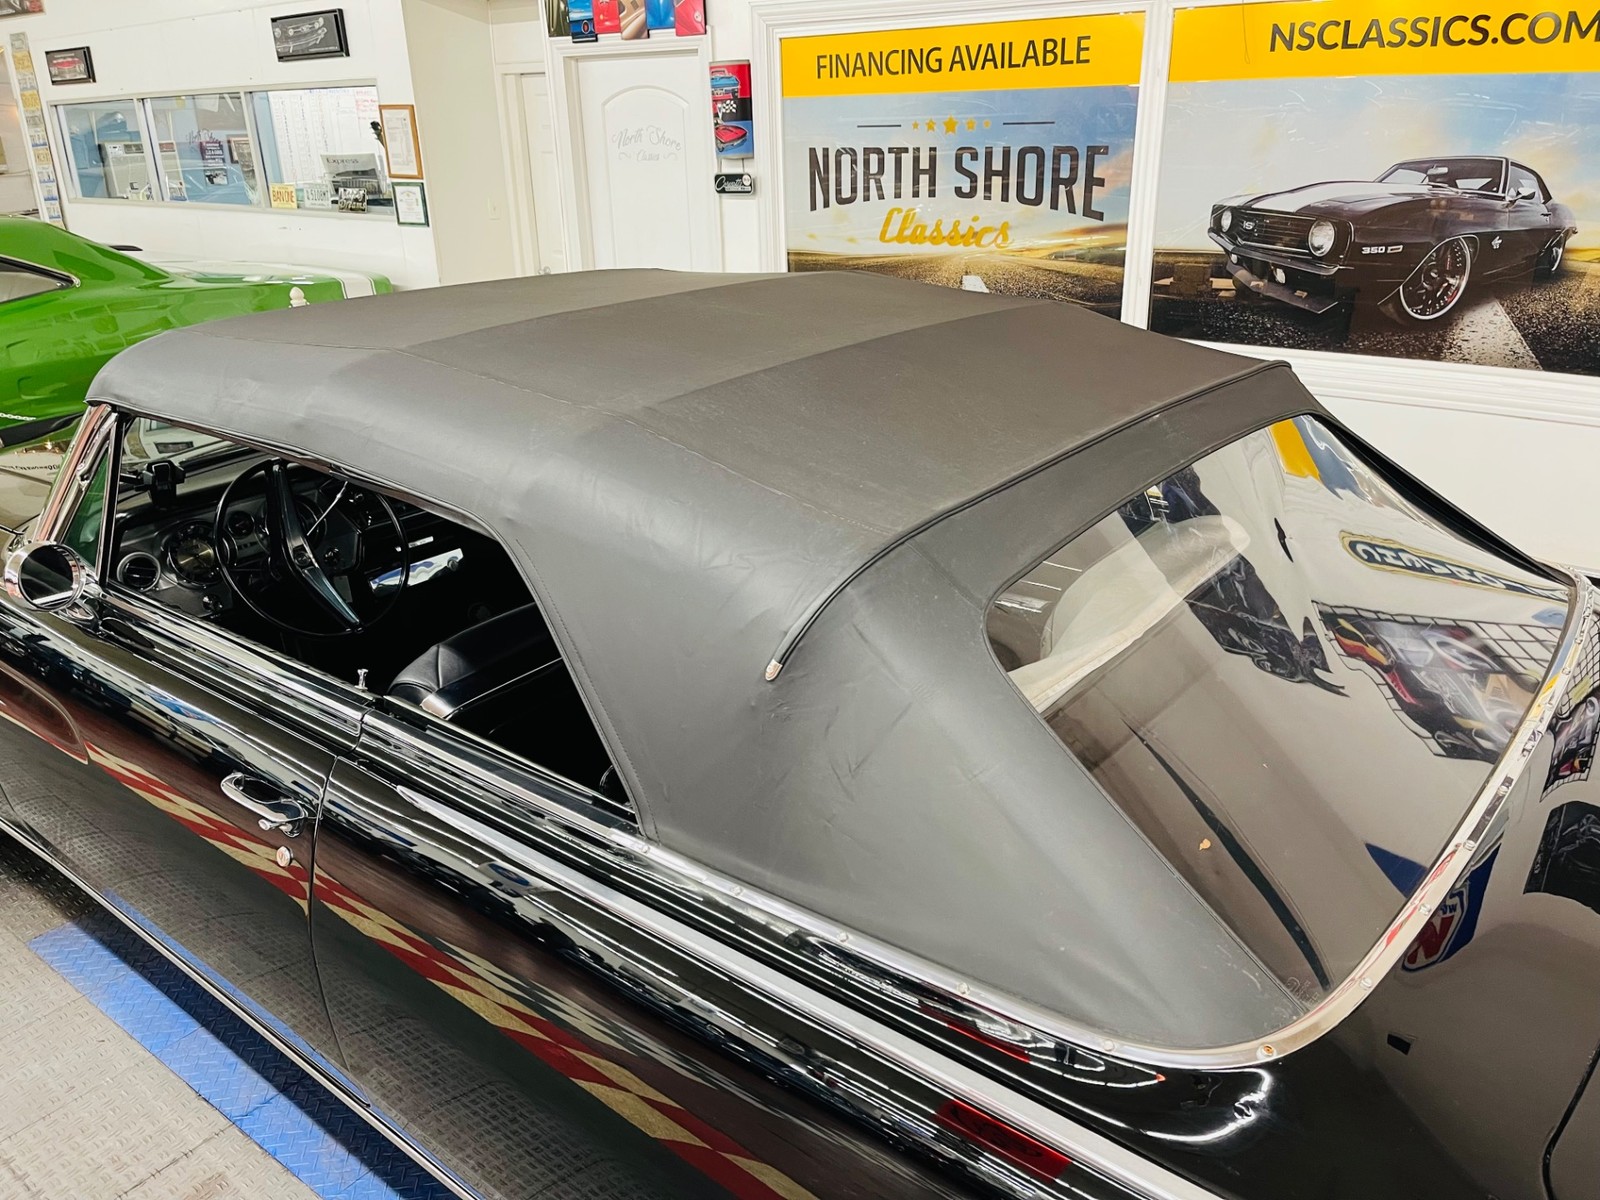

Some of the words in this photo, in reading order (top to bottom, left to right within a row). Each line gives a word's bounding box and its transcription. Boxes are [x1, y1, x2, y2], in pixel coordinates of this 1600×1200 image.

[1270, 9, 1600, 52] NSCLASSICS.COM
[816, 47, 943, 79] FINANCING
[948, 35, 1092, 72] AVAILABLE
[646, 125, 682, 151] Shore
[808, 147, 938, 212] NORTH
[954, 145, 1109, 222] SHORE
[879, 207, 1012, 248] Classics
[1361, 246, 1386, 255] 350
